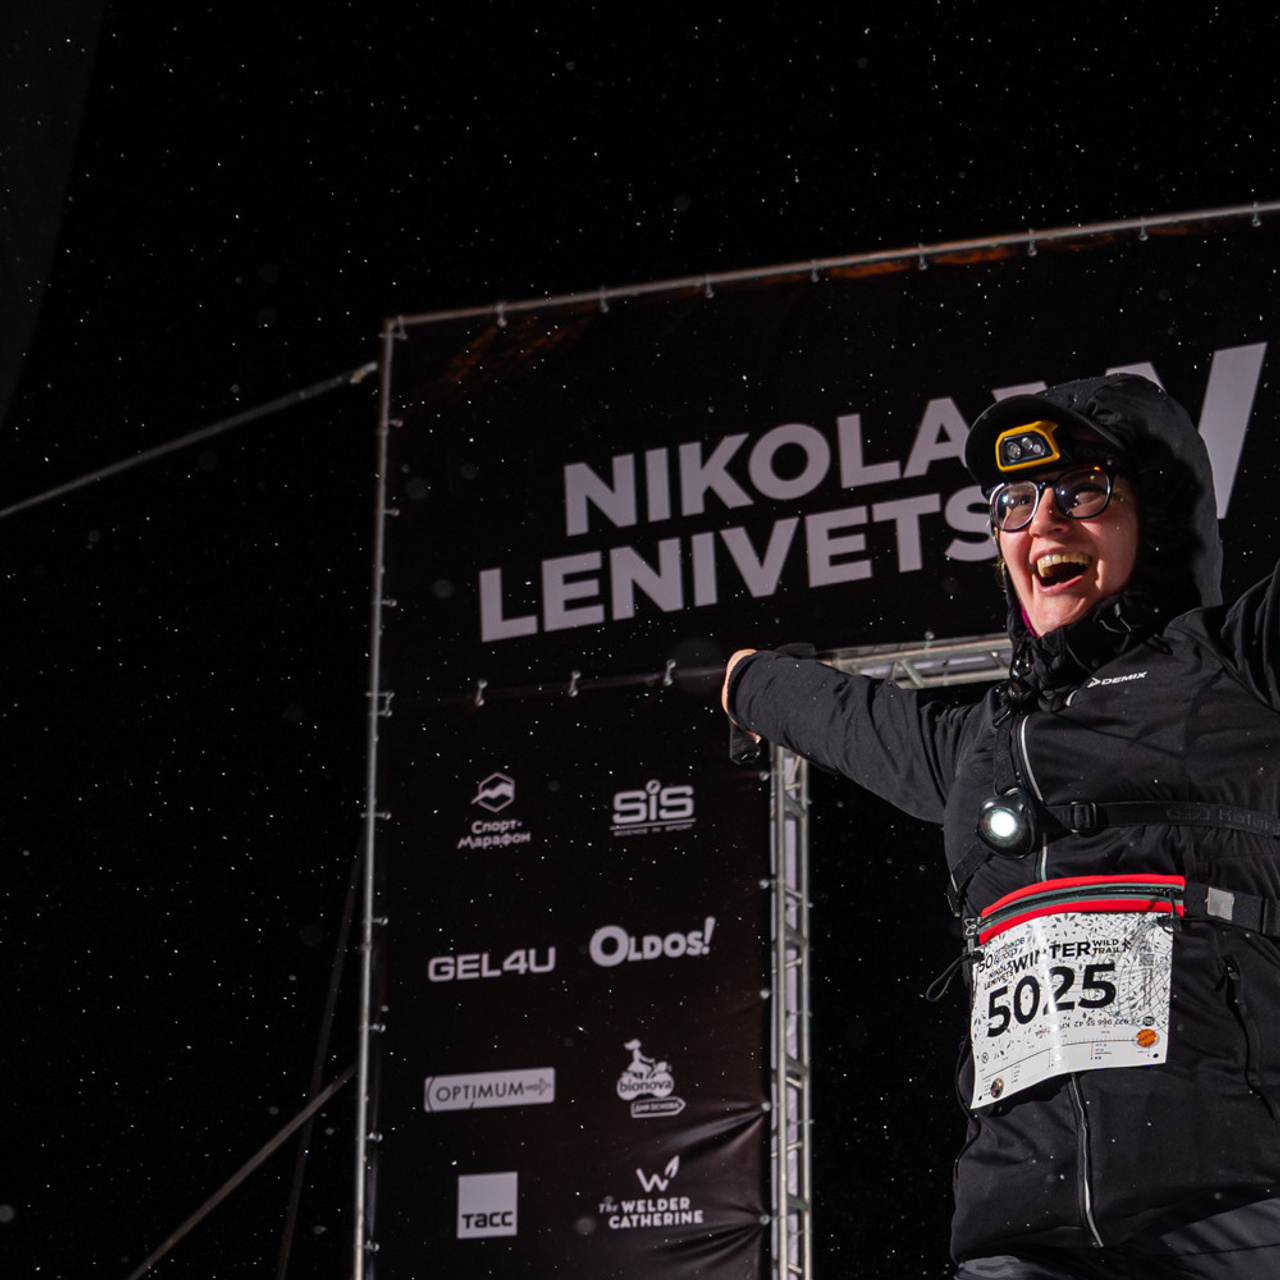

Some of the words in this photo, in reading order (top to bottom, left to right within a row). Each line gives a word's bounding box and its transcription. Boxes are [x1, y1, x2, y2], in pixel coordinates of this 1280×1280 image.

[564, 397, 974, 536] NIKOLA
[479, 483, 1002, 642] LENIVETS
[1101, 671, 1148, 685] DEMIX
[457, 831, 531, 849] Марафон
[1093, 947, 1120, 955] TRAIL
[427, 946, 557, 982] GEL4U
[986, 963, 1117, 1038] 5025
[436, 1080, 525, 1101] OPTIMUM
[620, 1079, 672, 1093] bionova
[599, 1202, 619, 1214] The
[621, 1197, 690, 1214] WELDER
[609, 1210, 703, 1229] CATHERINE
